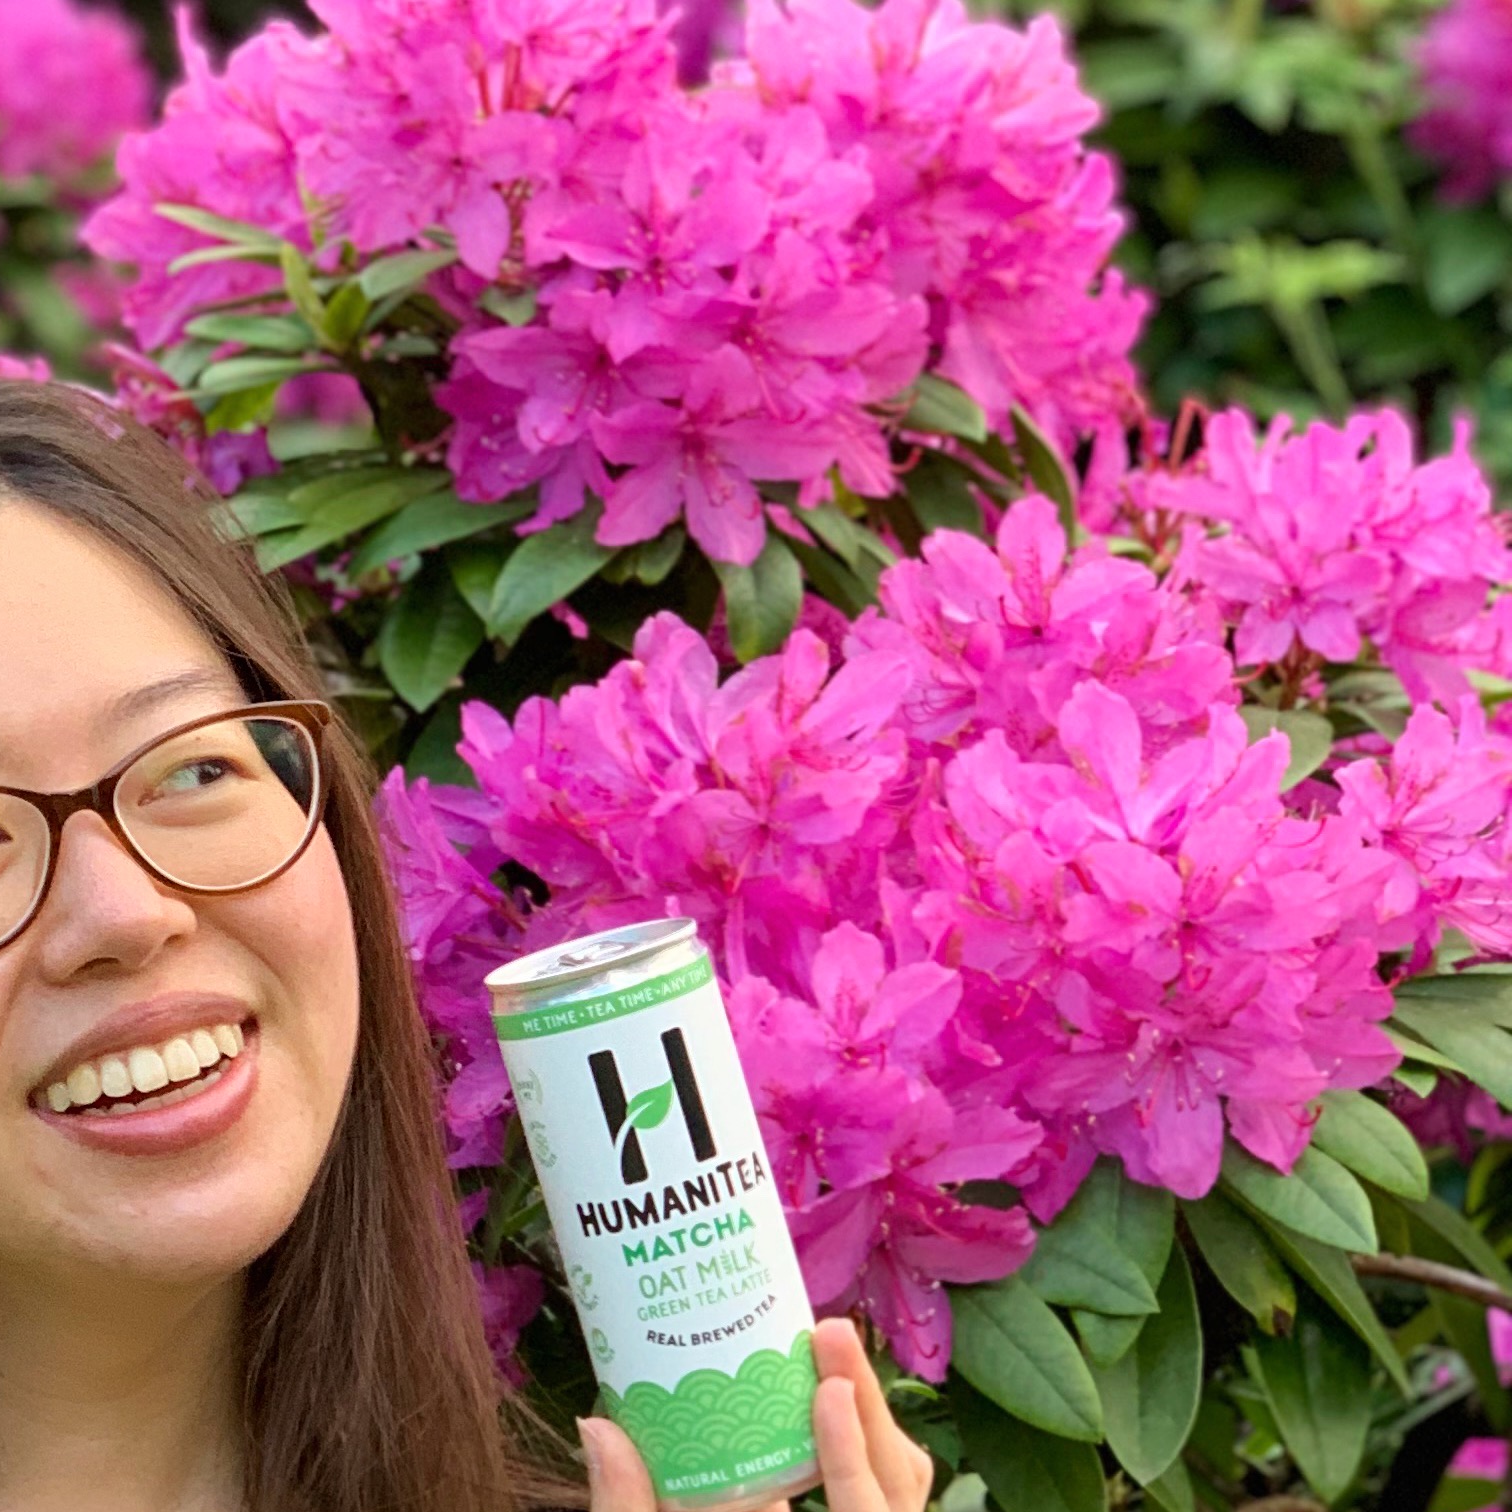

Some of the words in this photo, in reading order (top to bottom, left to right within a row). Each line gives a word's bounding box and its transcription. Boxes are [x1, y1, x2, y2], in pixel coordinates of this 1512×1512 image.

[522, 1017, 541, 1033] ME
[543, 1010, 578, 1030] TIME
[585, 1000, 616, 1019] TEA
[618, 988, 655, 1010] TIME
[661, 974, 687, 996] ANY
[576, 1151, 767, 1238] HUMANITEA
[621, 1207, 756, 1268] MATCHA
[637, 1297, 691, 1322] GREEN
[694, 1287, 729, 1307] TEA
[731, 1268, 774, 1296] LATTE
[638, 1265, 687, 1299] OAT
[646, 1329, 687, 1347] REAL
[690, 1313, 755, 1346] BREWED
[754, 1293, 777, 1317] TEA
[664, 1469, 730, 1492] NATURAL
[735, 1447, 793, 1478] ENERGY
